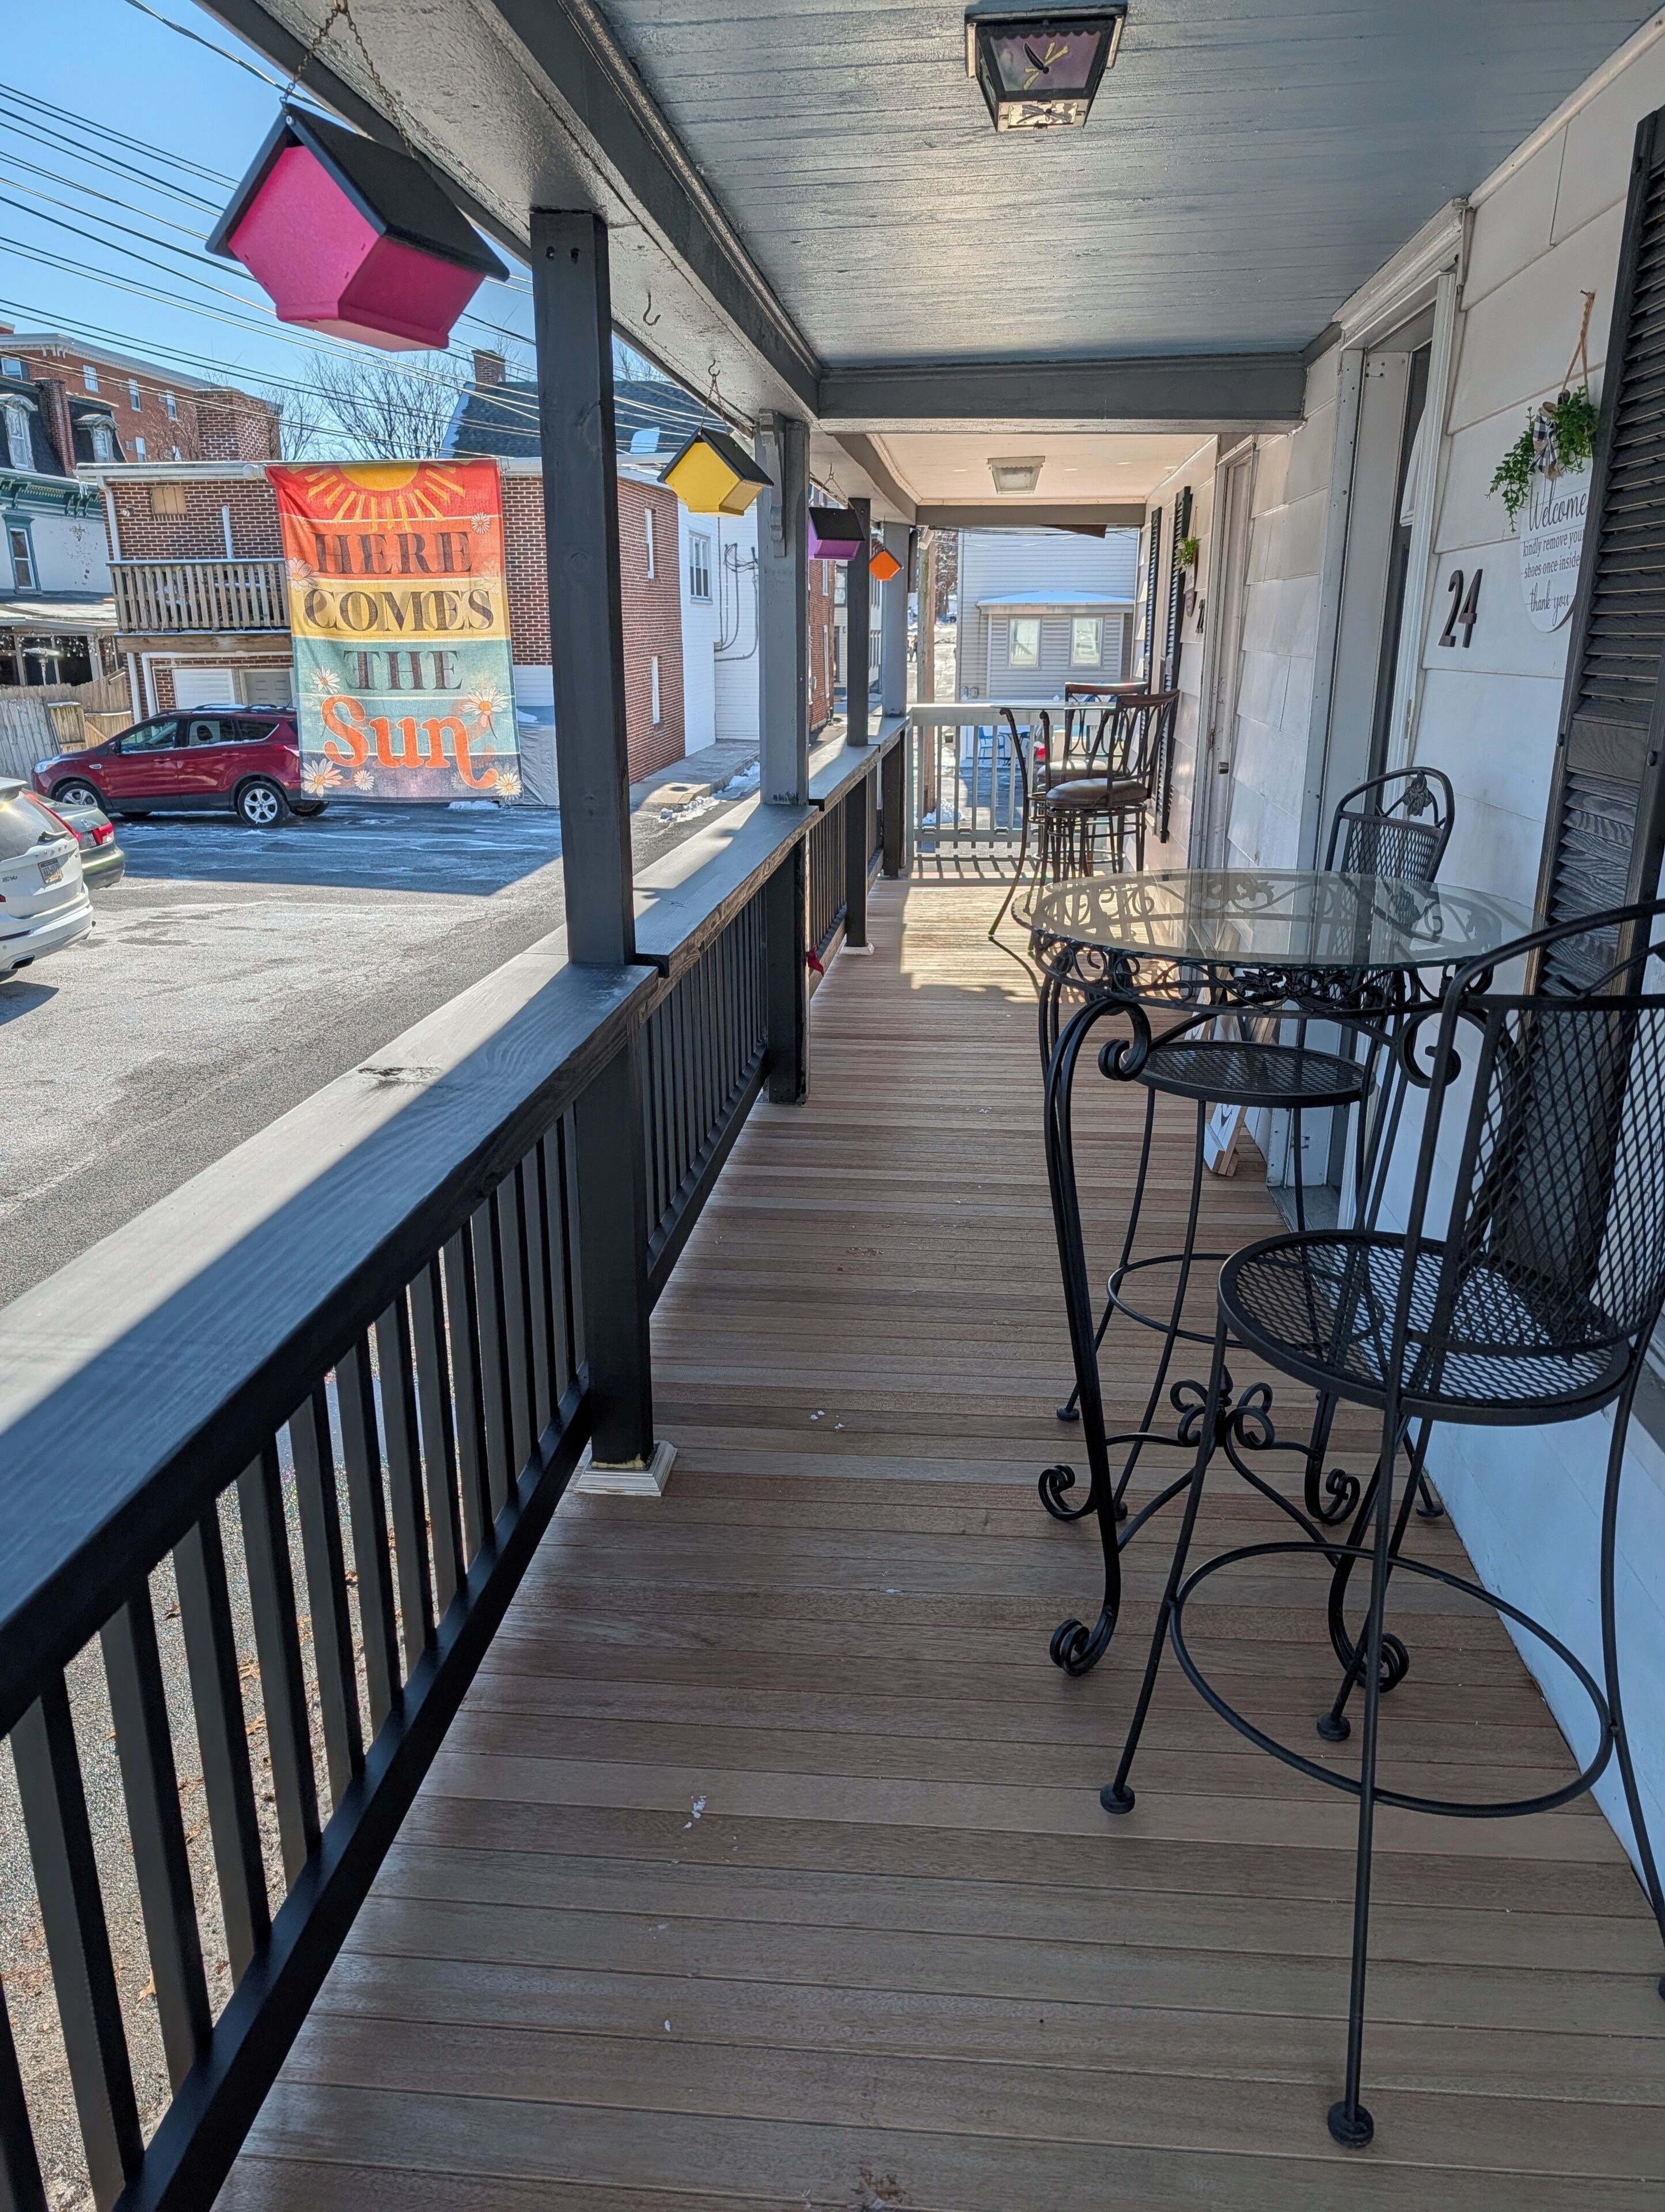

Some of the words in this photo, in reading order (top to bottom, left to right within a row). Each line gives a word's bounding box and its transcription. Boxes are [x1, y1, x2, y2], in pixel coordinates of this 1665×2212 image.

[1530, 477, 1588, 531] Welcome
[312, 531, 473, 574] HERE
[1523, 537, 1542, 557] kindly
[1543, 533, 1567, 551] remove
[1524, 562, 1541, 578] shoes
[1542, 560, 1558, 574] once
[1559, 551, 1580, 571] inside
[305, 589, 494, 632] COMES
[1438, 569, 1483, 648] 24
[1530, 579, 1550, 612] thank
[1552, 594, 1569, 626] you
[343, 650, 462, 690] THE
[321, 695, 499, 789] Sun
